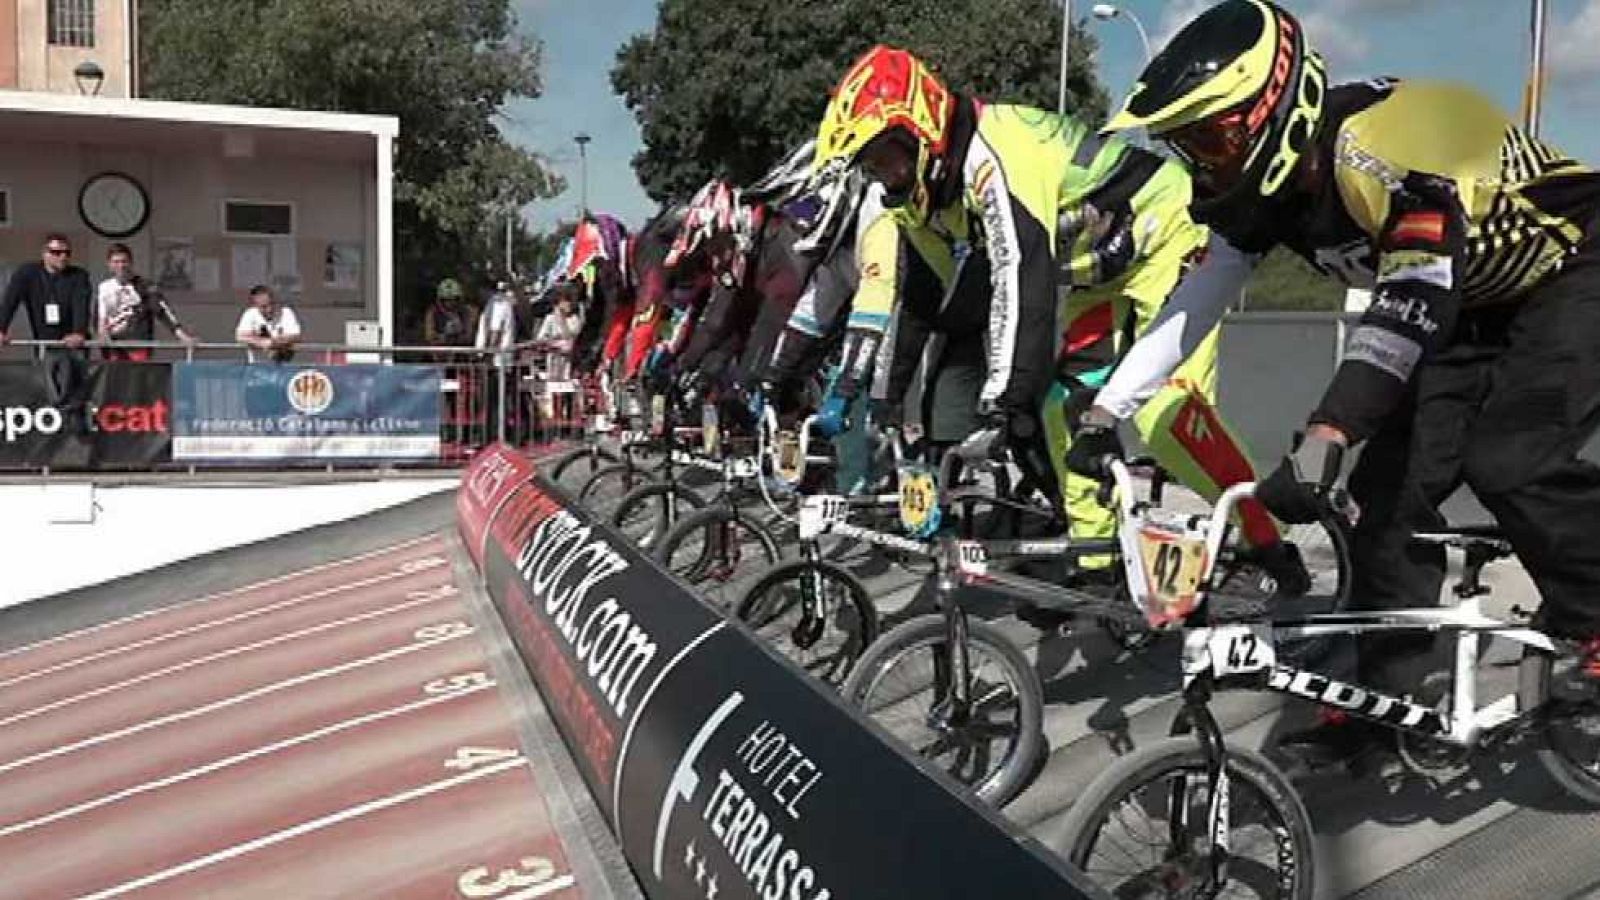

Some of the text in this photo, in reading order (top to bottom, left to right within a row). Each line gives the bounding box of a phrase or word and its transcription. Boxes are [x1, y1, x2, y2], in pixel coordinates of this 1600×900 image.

[1154, 543, 1183, 595] 42
[1227, 633, 1258, 669] 42
[1267, 664, 1434, 726] SCOTT
[444, 746, 519, 769] 4
[735, 719, 824, 820] HOTEL
[702, 768, 832, 900] TERRASS
[458, 855, 556, 899] 3
